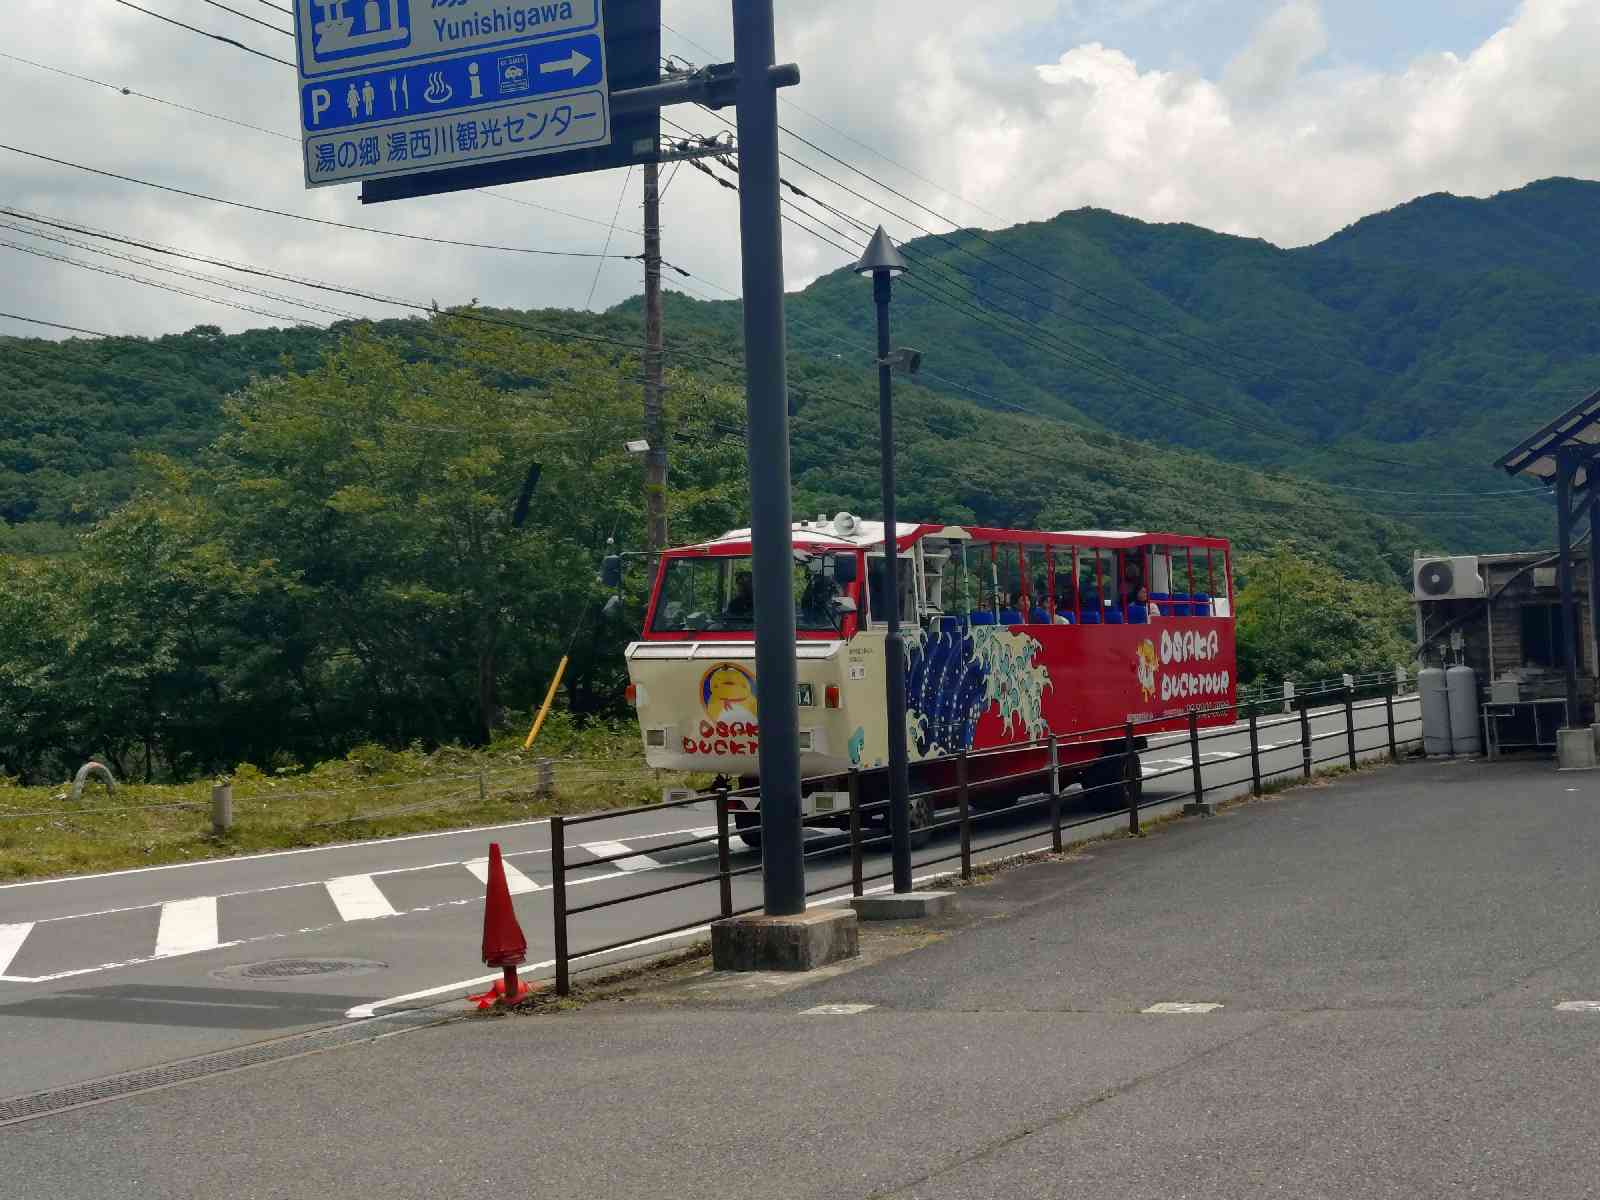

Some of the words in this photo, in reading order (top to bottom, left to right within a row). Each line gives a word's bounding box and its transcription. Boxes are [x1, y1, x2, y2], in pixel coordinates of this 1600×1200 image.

[433, 2, 572, 42] Yunishigawa
[312, 89, 331, 124] P
[315, 136, 380, 172] 湯の郷
[387, 105, 596, 161] 湯西川観光センター
[1161, 629, 1218, 664] OSAKA
[682, 736, 759, 755] DUCKT
[699, 720, 760, 738] OSAK
